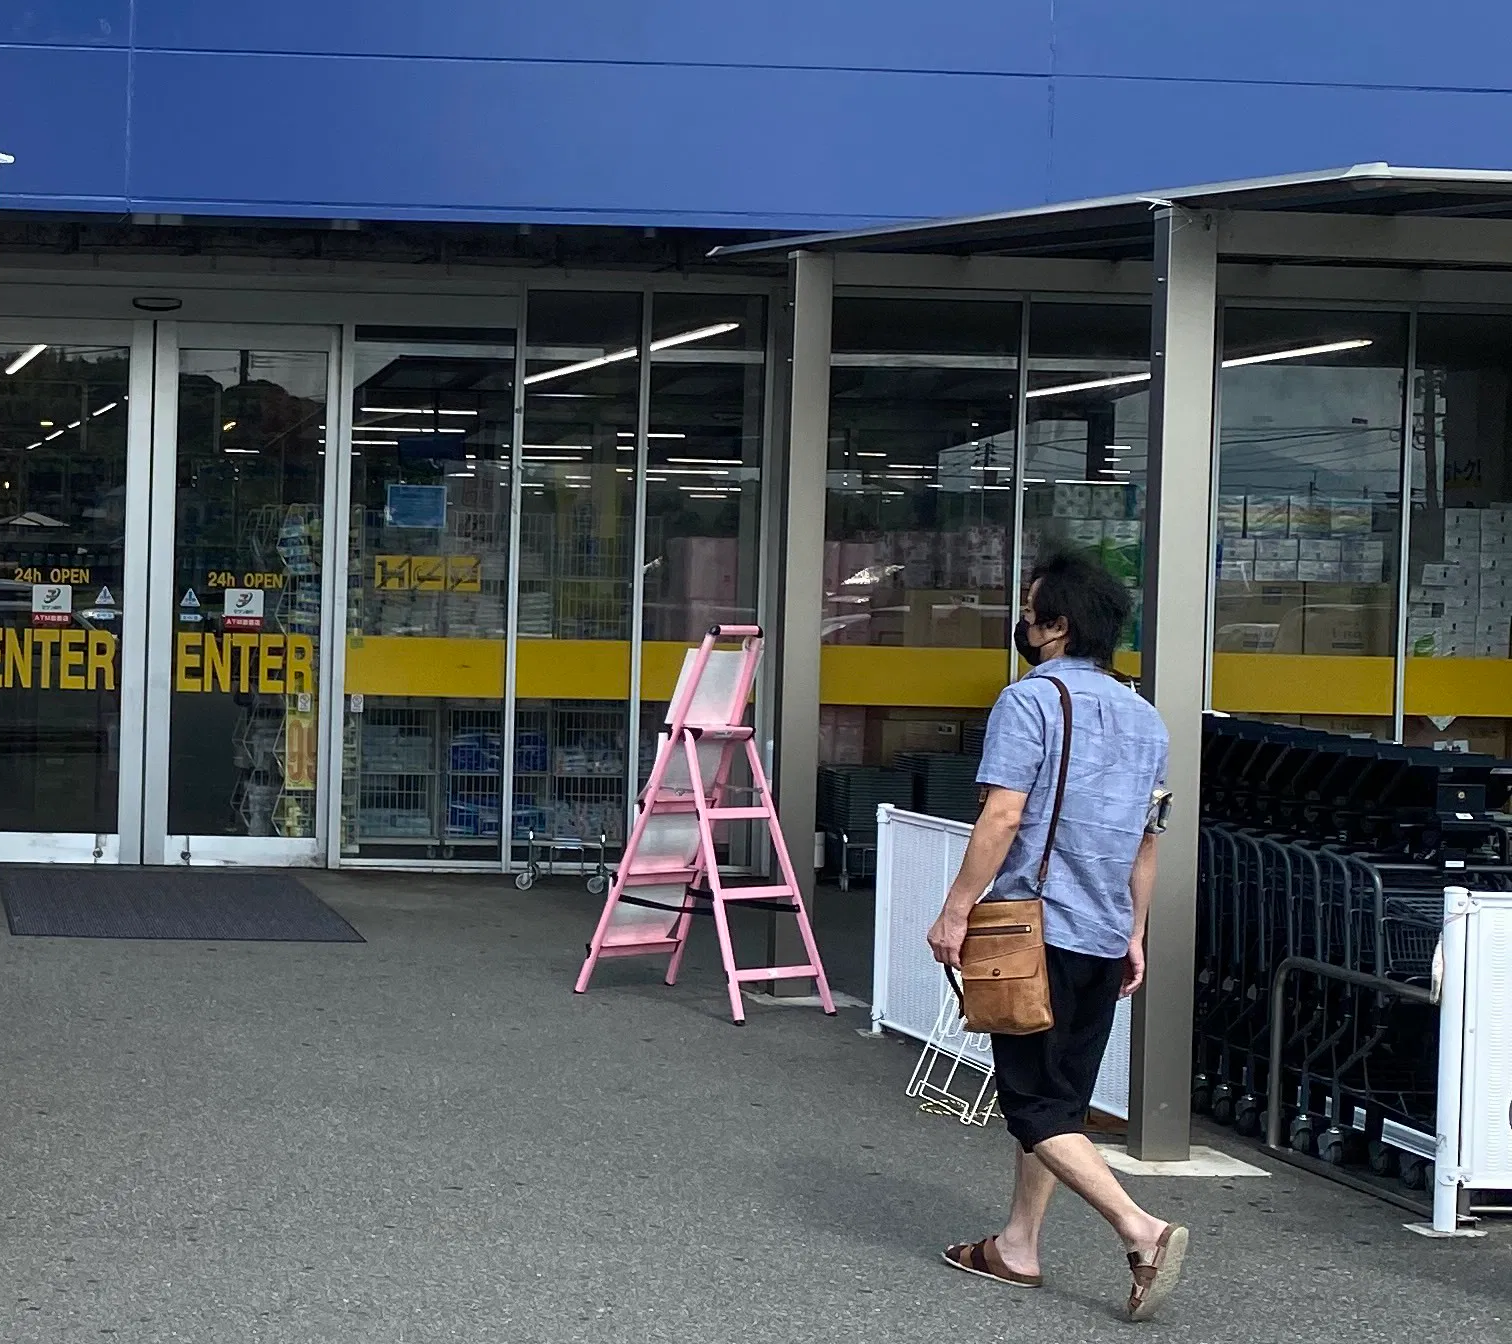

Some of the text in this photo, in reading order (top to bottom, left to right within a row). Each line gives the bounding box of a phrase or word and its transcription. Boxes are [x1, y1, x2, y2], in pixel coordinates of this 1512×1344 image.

[14, 567, 90, 584] 24h OPEN
[208, 571, 283, 588] 24h OPEN
[176, 632, 314, 694] ENTER
